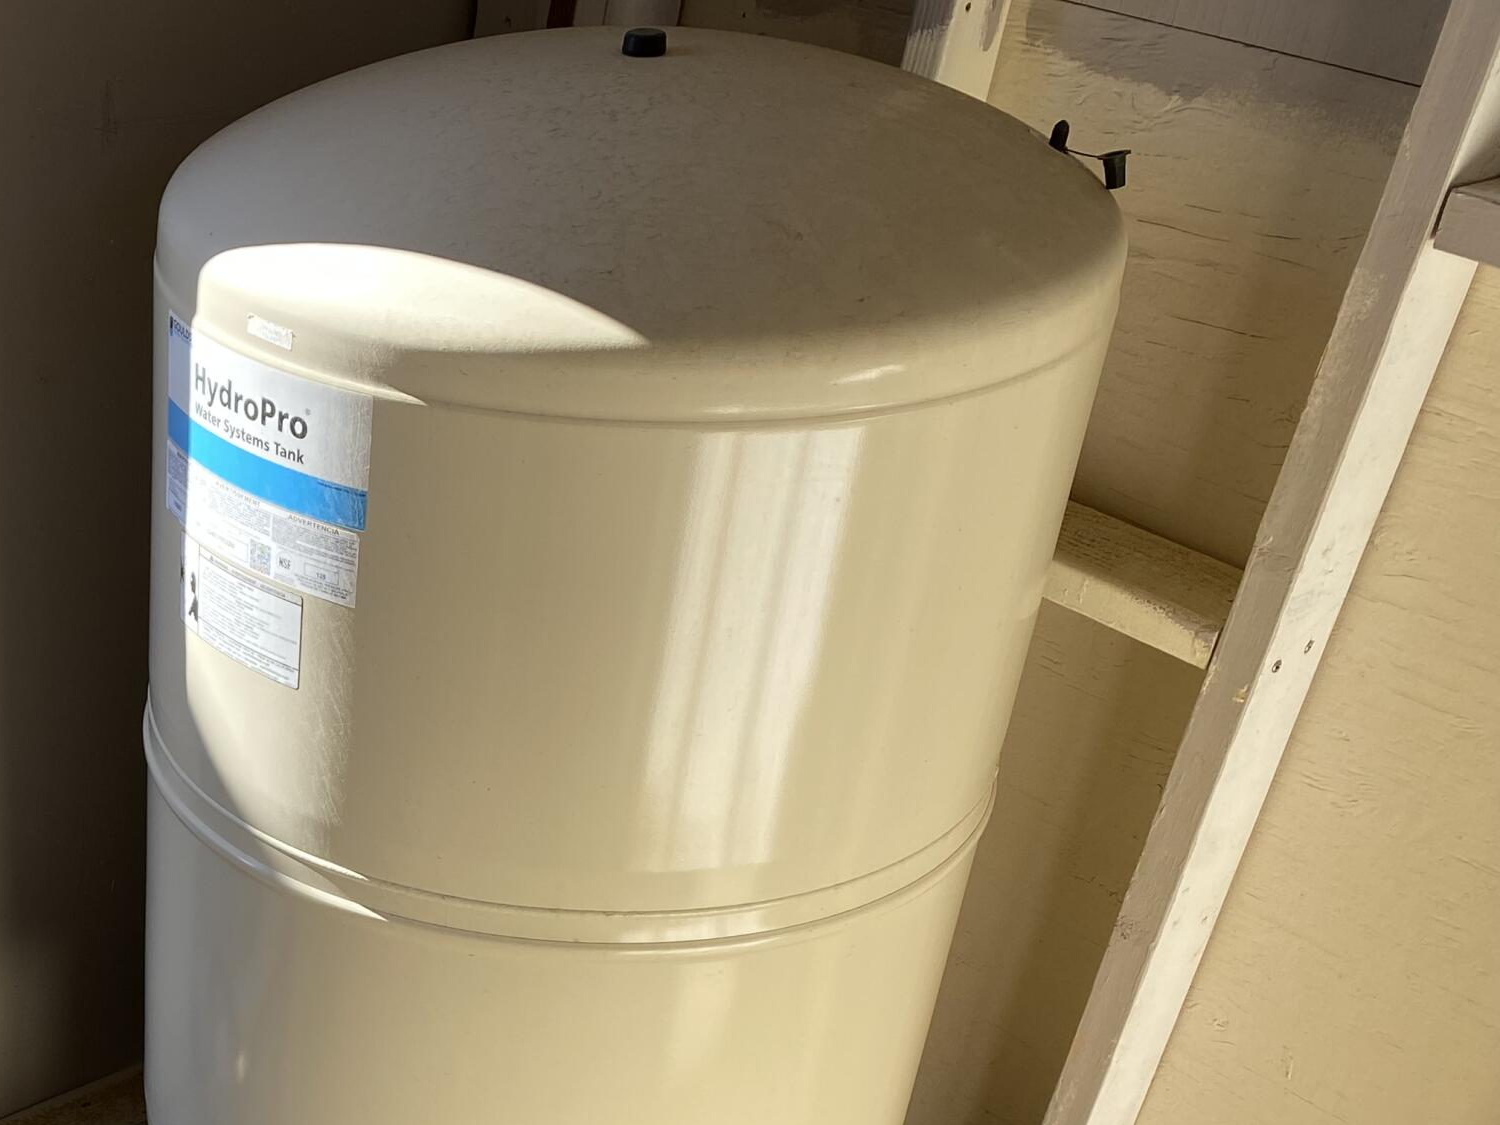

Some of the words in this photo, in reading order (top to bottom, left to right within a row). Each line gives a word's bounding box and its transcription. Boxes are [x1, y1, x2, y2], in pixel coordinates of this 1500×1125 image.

[195, 363, 307, 439] HydroPro
[195, 401, 221, 428] Water
[223, 420, 269, 452] Systems
[273, 441, 304, 464] Tank
